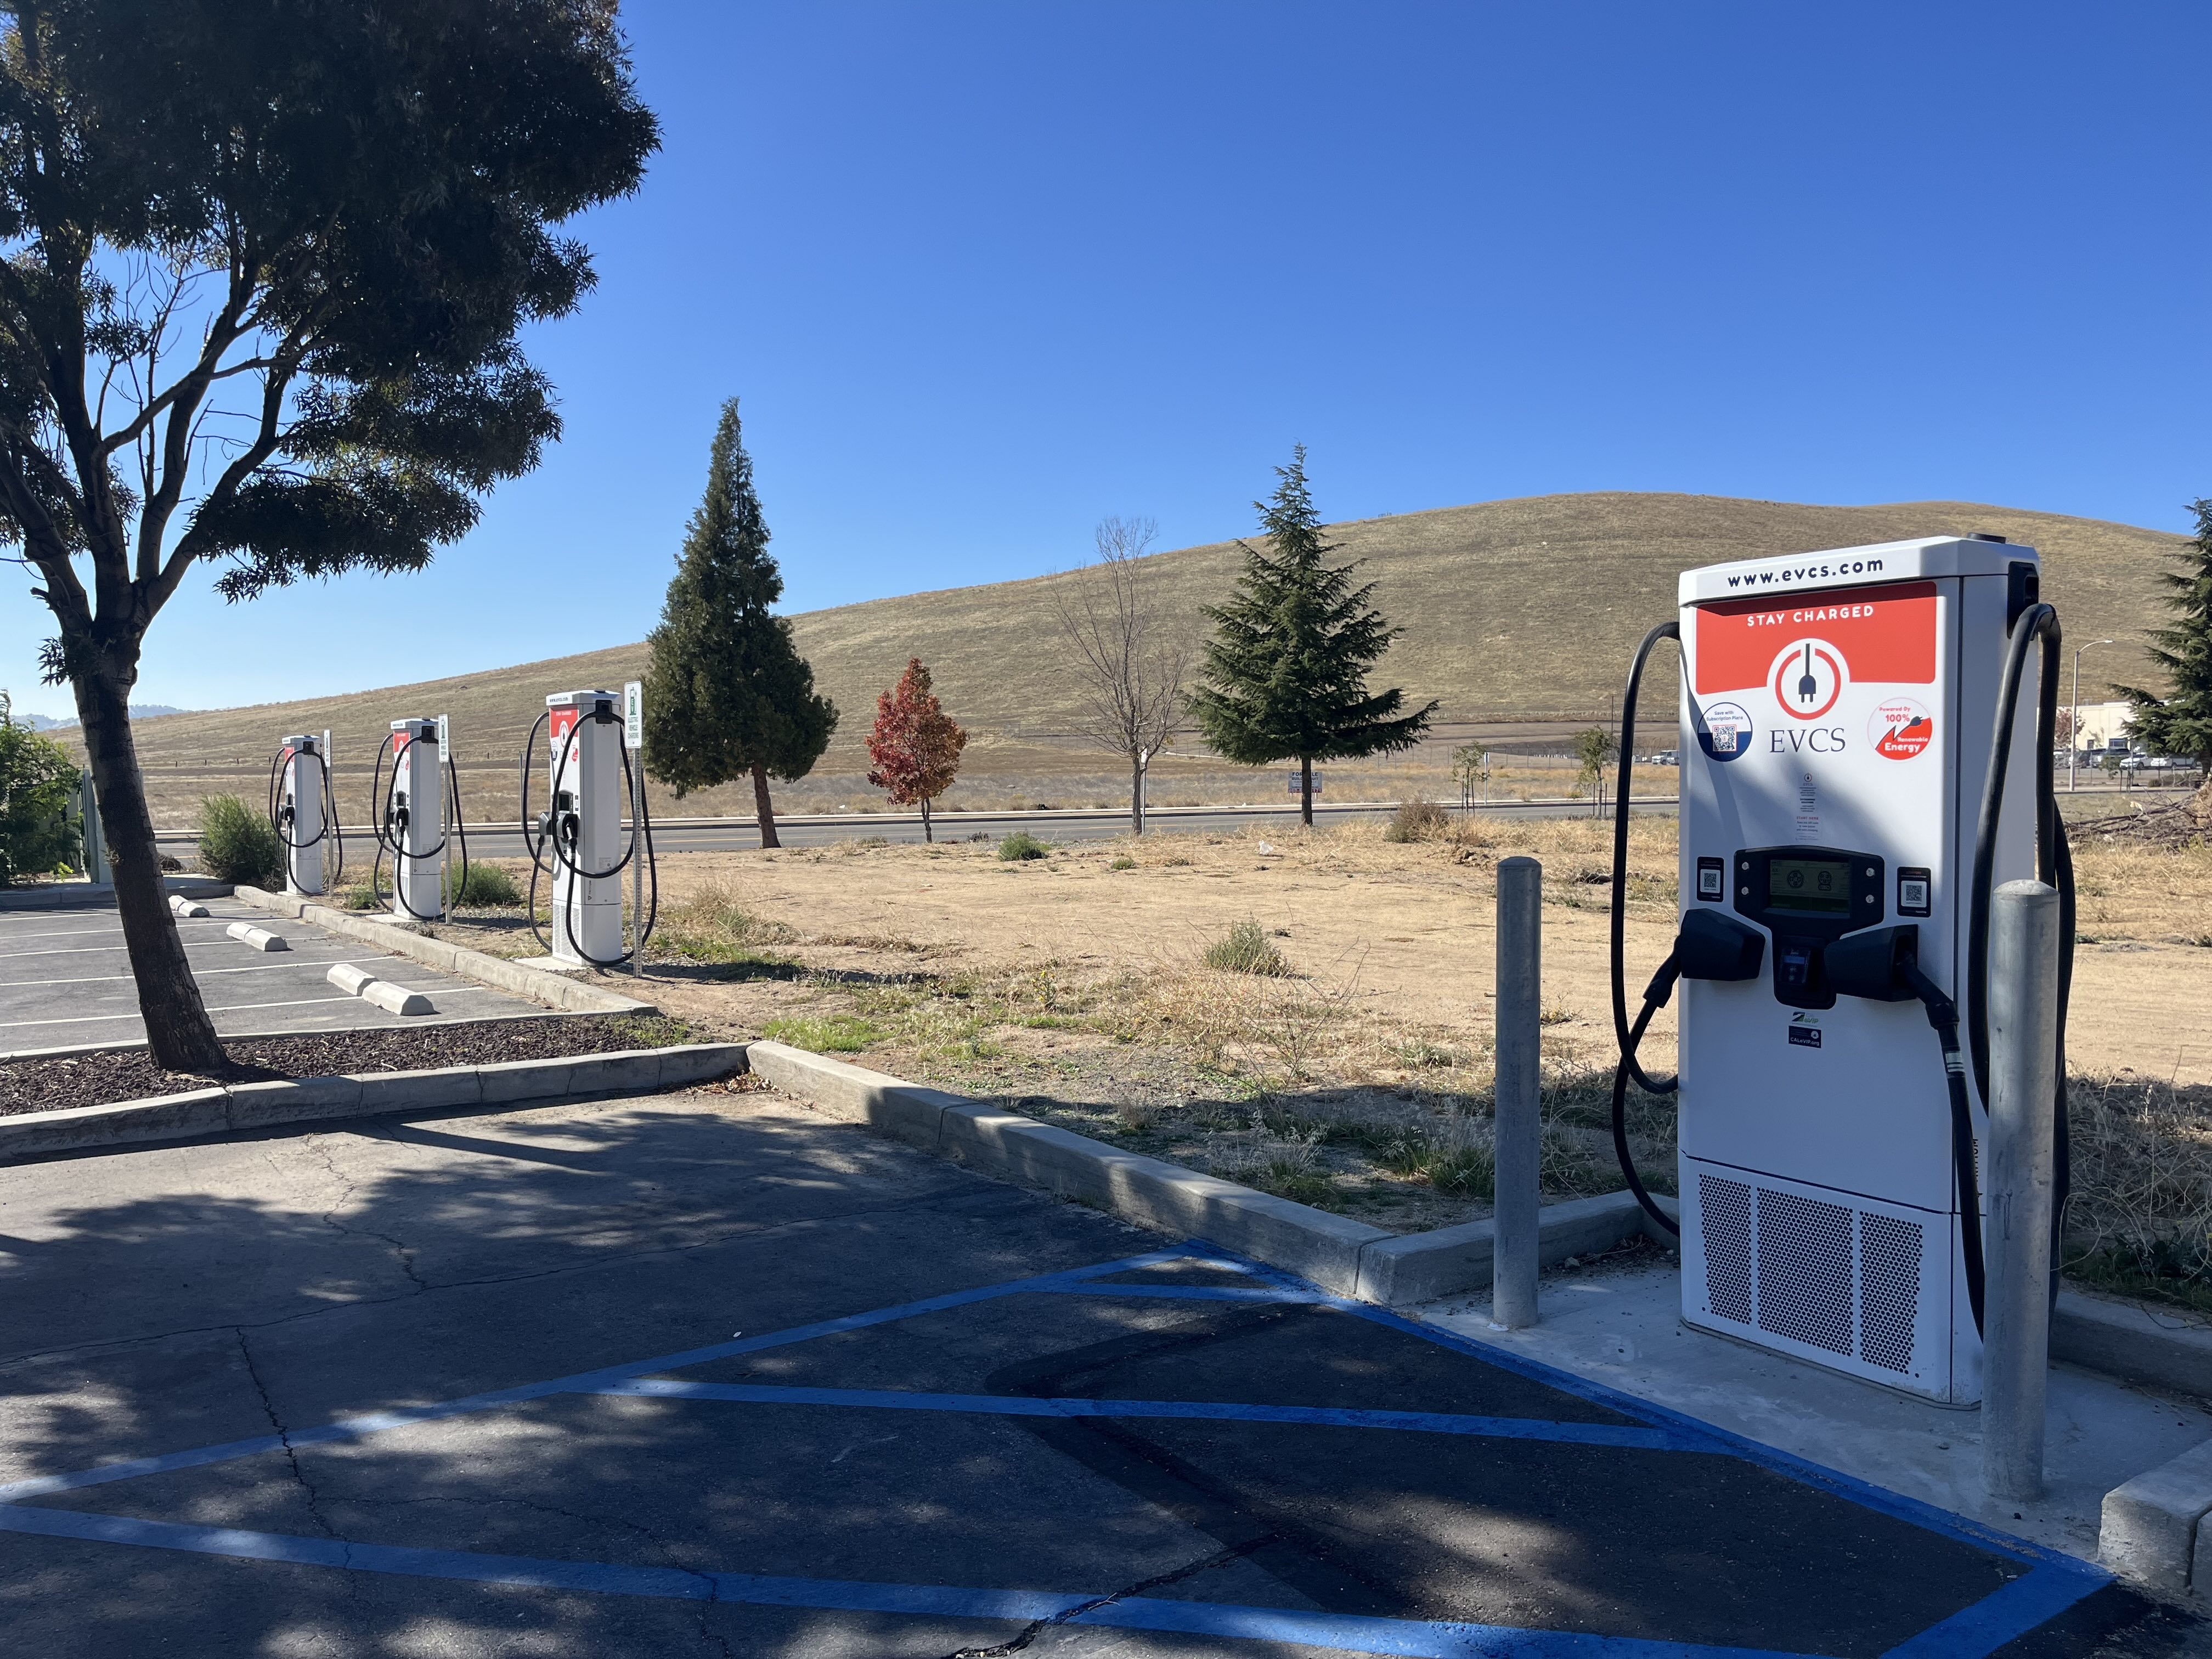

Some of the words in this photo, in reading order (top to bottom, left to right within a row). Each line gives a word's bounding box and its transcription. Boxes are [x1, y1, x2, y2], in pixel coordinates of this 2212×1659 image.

[1728, 559, 1883, 587] www.evcs.com
[1747, 613, 1785, 627] STAY
[1793, 605, 1874, 623] CHARGED
[1886, 714, 1910, 723] 100%
[1769, 727, 1846, 753] EVCS
[1884, 742, 1921, 753] Energy
[1790, 1037, 1820, 1046] CALeVIP.org
